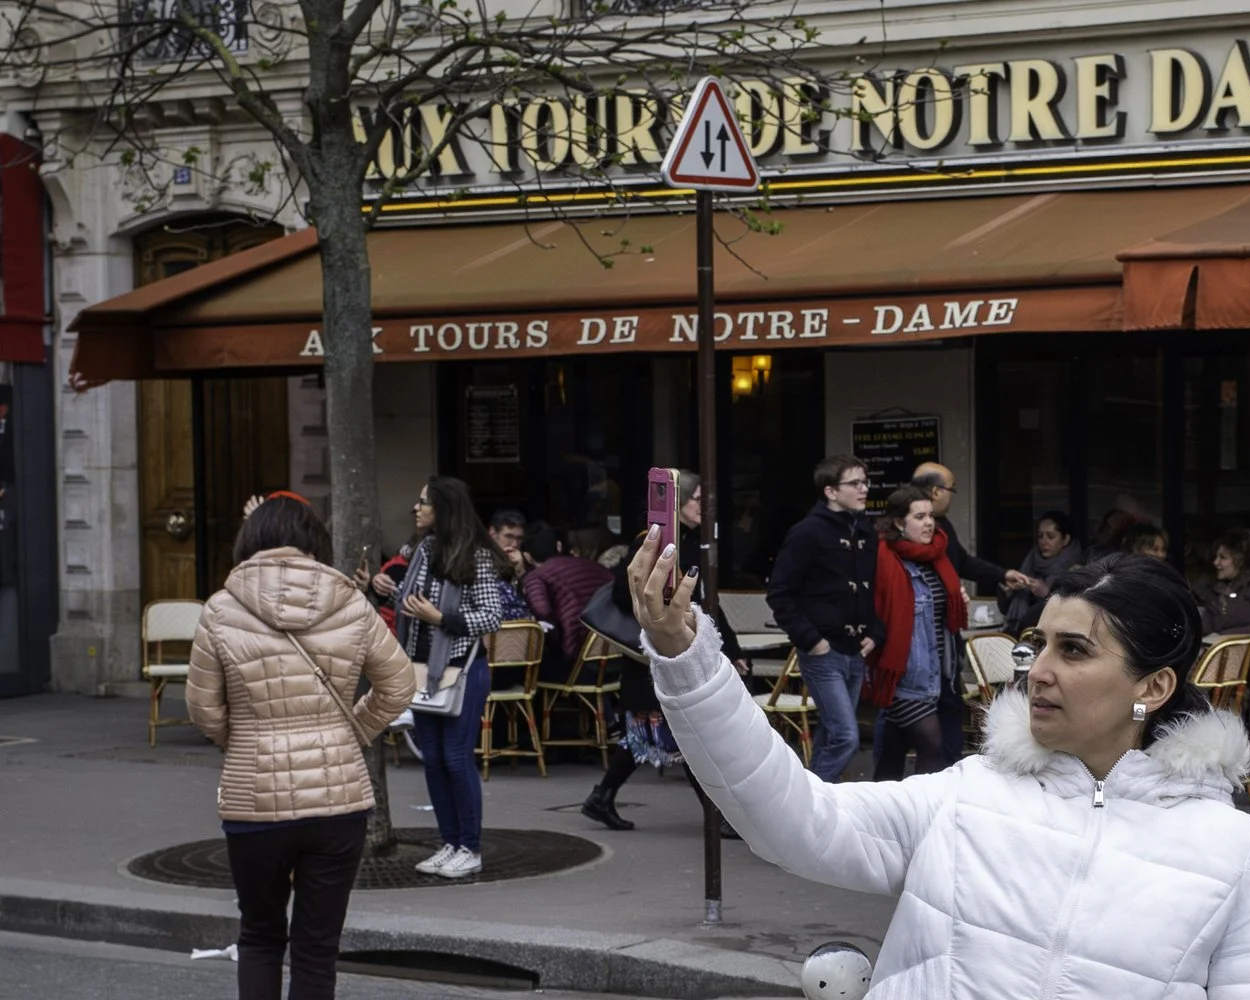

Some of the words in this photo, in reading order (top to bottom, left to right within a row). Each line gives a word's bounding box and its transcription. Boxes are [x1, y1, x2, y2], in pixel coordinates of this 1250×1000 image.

[489, 88, 688, 172] TOUR
[732, 76, 829, 160] DE
[848, 54, 1127, 153] NOTRE
[410, 320, 549, 353] TOURS
[577, 315, 639, 345] DE
[669, 308, 829, 342] NOTRE
[870, 298, 1018, 336] DAME
